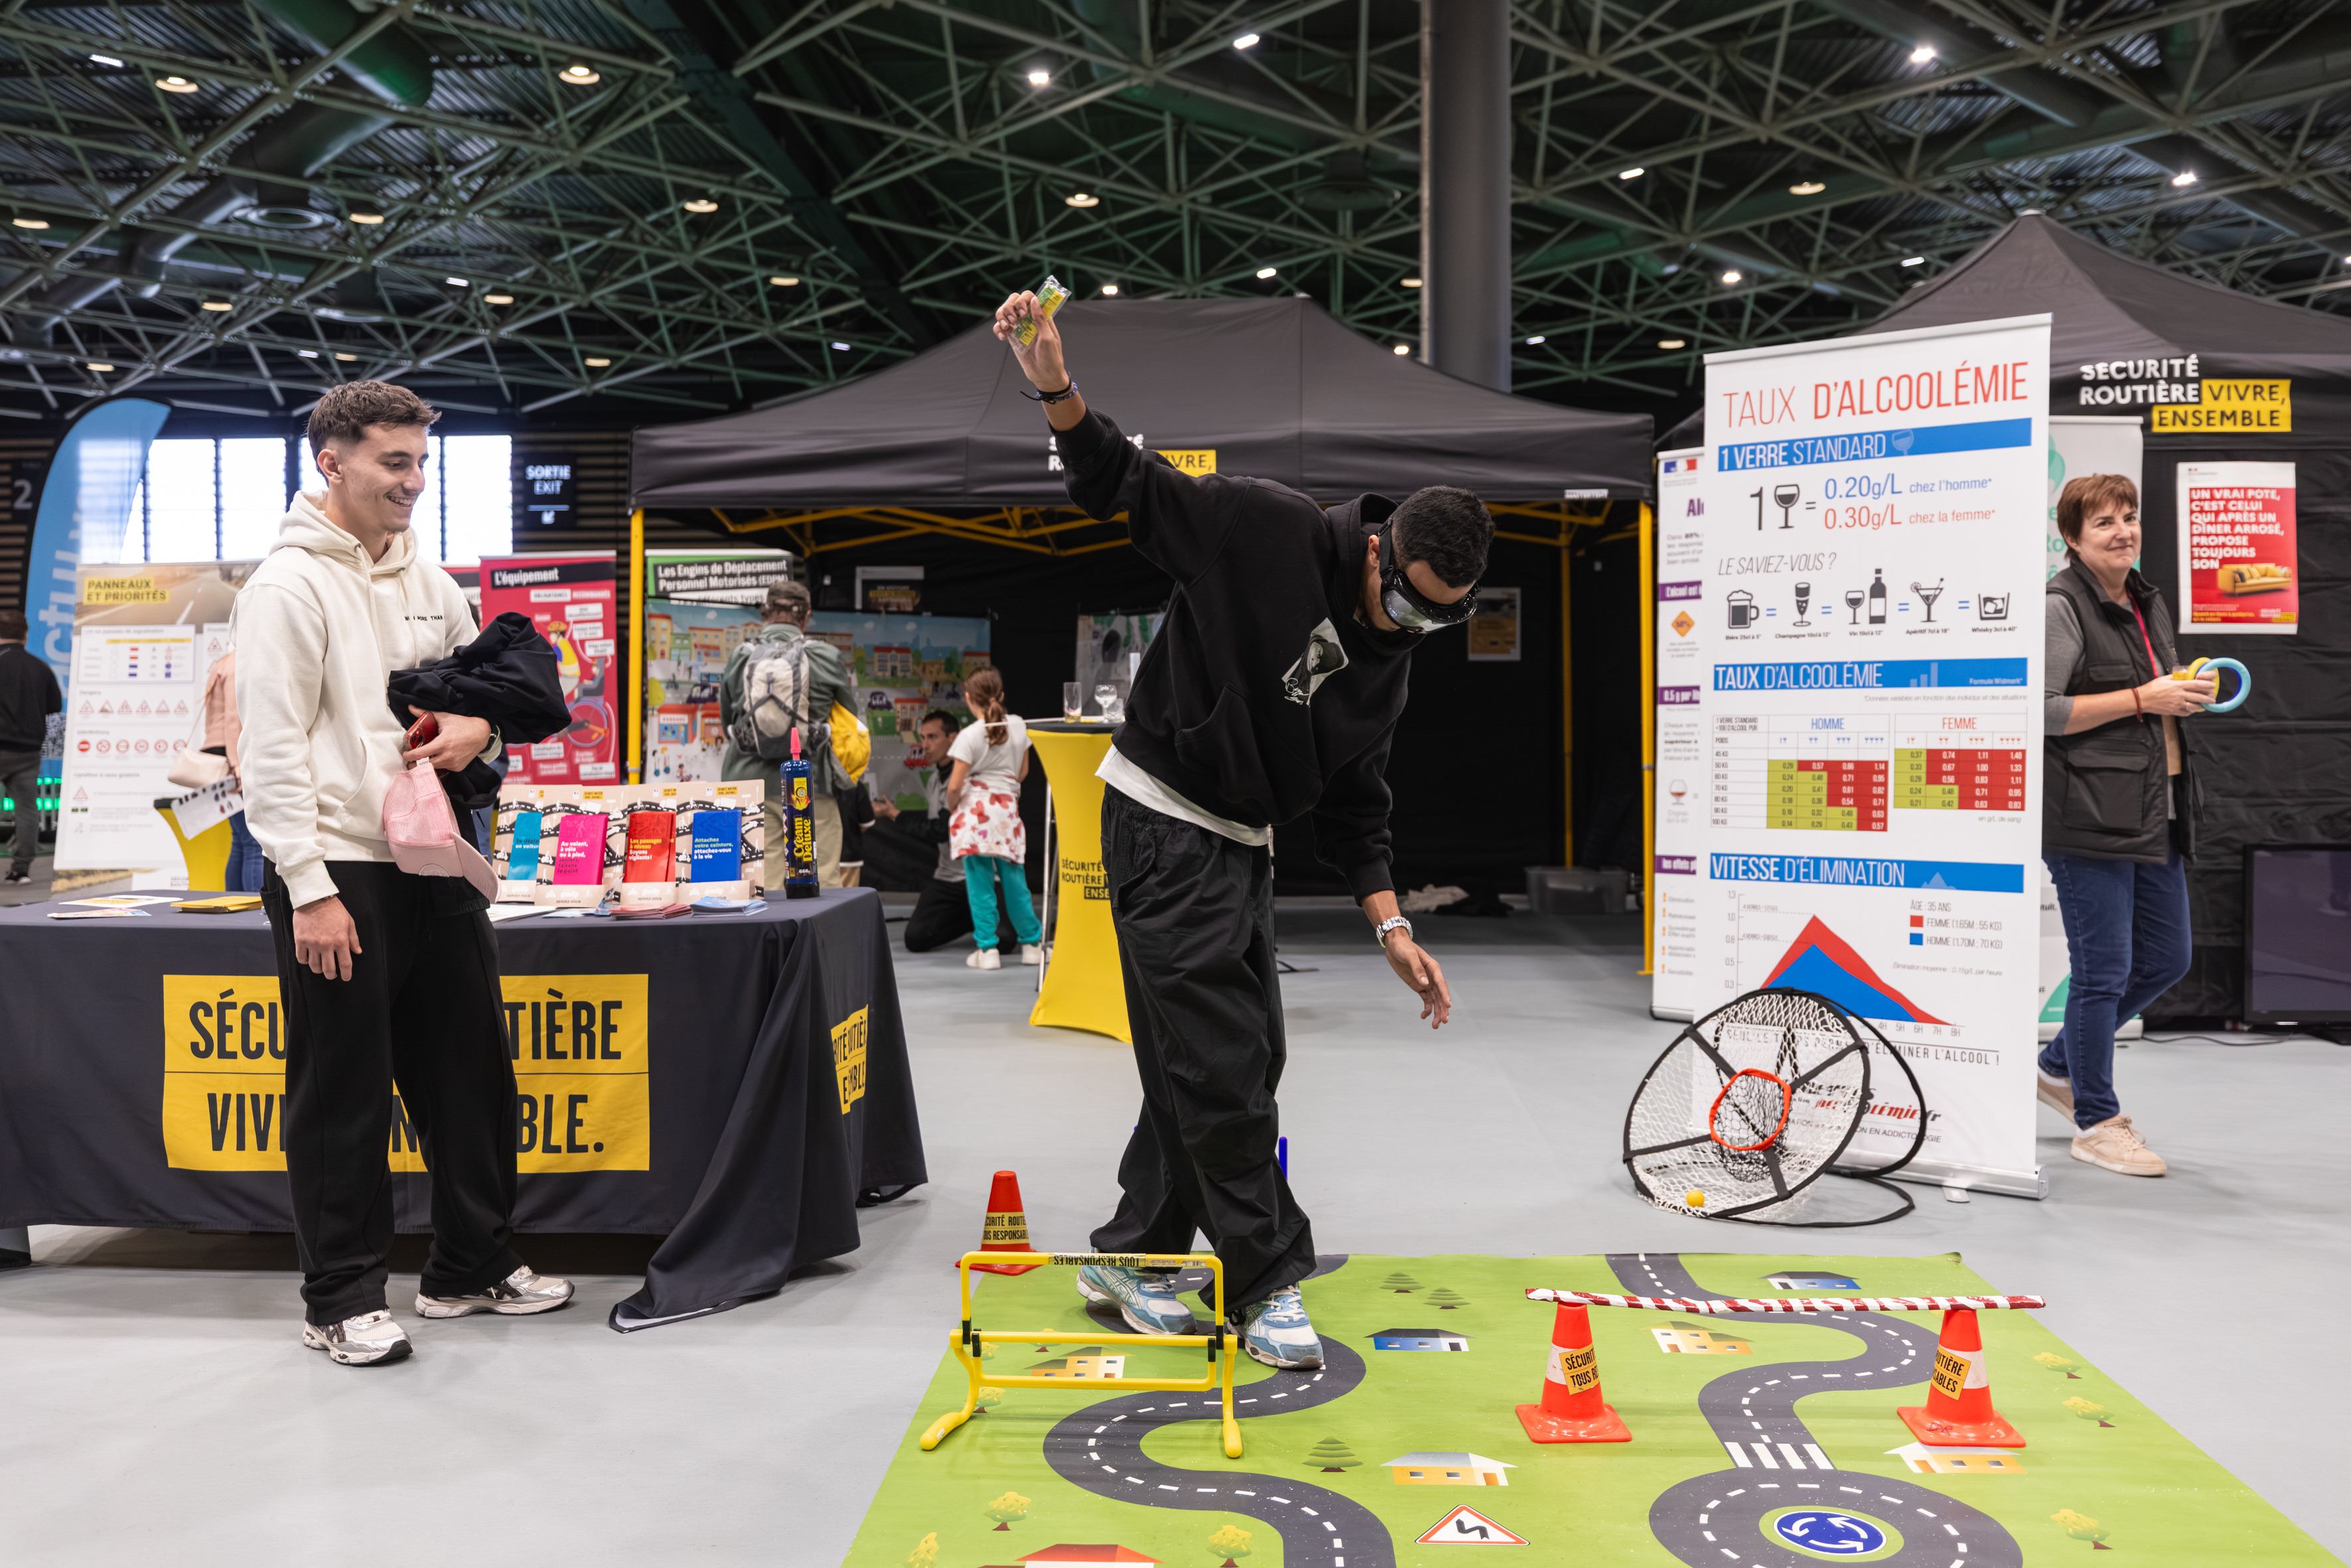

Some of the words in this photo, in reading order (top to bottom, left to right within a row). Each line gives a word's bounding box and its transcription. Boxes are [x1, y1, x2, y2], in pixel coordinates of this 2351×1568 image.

[1723, 386, 1796, 428] TAUX
[1814, 360, 2029, 419] D'ALCOOLÉMIE
[2079, 379, 2200, 405] ROUTIÈRE
[2208, 384, 2286, 405] VIVRE,
[2158, 410, 2281, 426] ENSEMBLE
[1721, 448, 1729, 470] 1
[1734, 442, 1789, 468] VERRE
[1792, 433, 1886, 464] STANDARD
[1167, 455, 1212, 471] IVRE,
[526, 465, 571, 480] SORTIE
[13, 478, 33, 510] 2
[534, 480, 563, 494] EXIT
[2191, 489, 2210, 499] UN
[2213, 489, 2244, 499] VRAI
[2247, 489, 2281, 501] POTE,
[1750, 486, 1763, 530] 1
[1824, 472, 1902, 500] 0.20g/L
[1909, 482, 1936, 494] chez
[2190, 500, 2226, 511] C'EST
[2228, 500, 2263, 511] CELUI
[1824, 503, 1902, 530] 0.30g/L
[1908, 512, 1935, 525] chez
[1938, 511, 1948, 522] la
[2190, 512, 2215, 524] QUI
[2217, 511, 2256, 522] APRÈS
[2259, 512, 2276, 522] UN
[2234, 522, 2284, 536] ARROSÉ,
[2192, 535, 2249, 545] PROPOSE
[2191, 547, 2256, 559] TOUJOURS
[658, 565, 676, 577] Les
[677, 564, 709, 579] Engins
[710, 563, 723, 575] de
[724, 559, 787, 575] Déplacement
[1718, 557, 1736, 576] LE
[1737, 552, 1825, 575] SAVIEZ-VOUS
[2192, 559, 2220, 569] SON
[88, 579, 151, 589] PANNEAUX
[494, 567, 559, 587] L'équipement
[659, 577, 707, 592] Personnel
[709, 574, 757, 589] Motorisés
[758, 574, 788, 587] (EDPM)
[87, 592, 101, 601] ET
[104, 589, 167, 601] PRIORITÉS
[1715, 666, 1760, 689] TAUX
[1764, 661, 1883, 689] D'ALCOOLÉMIE
[1811, 718, 1845, 730] HOMME
[1942, 717, 1977, 729] FEMME
[794, 817, 804, 858] Cream
[803, 818, 813, 862] Deluxe
[1062, 857, 1102, 872] SÉCURITÉ
[1711, 855, 1780, 881] VITESSE
[1784, 856, 1904, 886] D'ÉLIMINATION
[1062, 872, 1102, 885] ROUTIÈRE
[1086, 888, 1109, 898] ENSE
[1910, 899, 1924, 910] ÂGE
[1928, 902, 1936, 911] 35
[1938, 902, 1952, 912] ANS
[1927, 918, 1950, 928] FEMME
[1979, 921, 1989, 930] 55
[1990, 921, 2002, 930] KG)
[1926, 936, 1951, 946] HOMME
[1980, 939, 1989, 948] 70
[1990, 939, 2003, 949] KG)
[189, 988, 287, 1060] SÉCU
[503, 987, 622, 1060] TIÈRE
[1896, 1023, 1905, 1032] 5H
[1914, 1025, 1923, 1033] 6H
[1933, 1026, 1942, 1035] 7H
[1951, 1028, 1960, 1036] 8H
[1935, 1048, 1989, 1065] L'ALCOOL
[207, 1092, 286, 1151] VIV
[1119, 1256, 1139, 1267] TOUS
[1565, 1348, 1595, 1370] SÉCURIT
[1935, 1350, 1965, 1377] OUTIÈRE
[1570, 1370, 1592, 1388] TOUS
